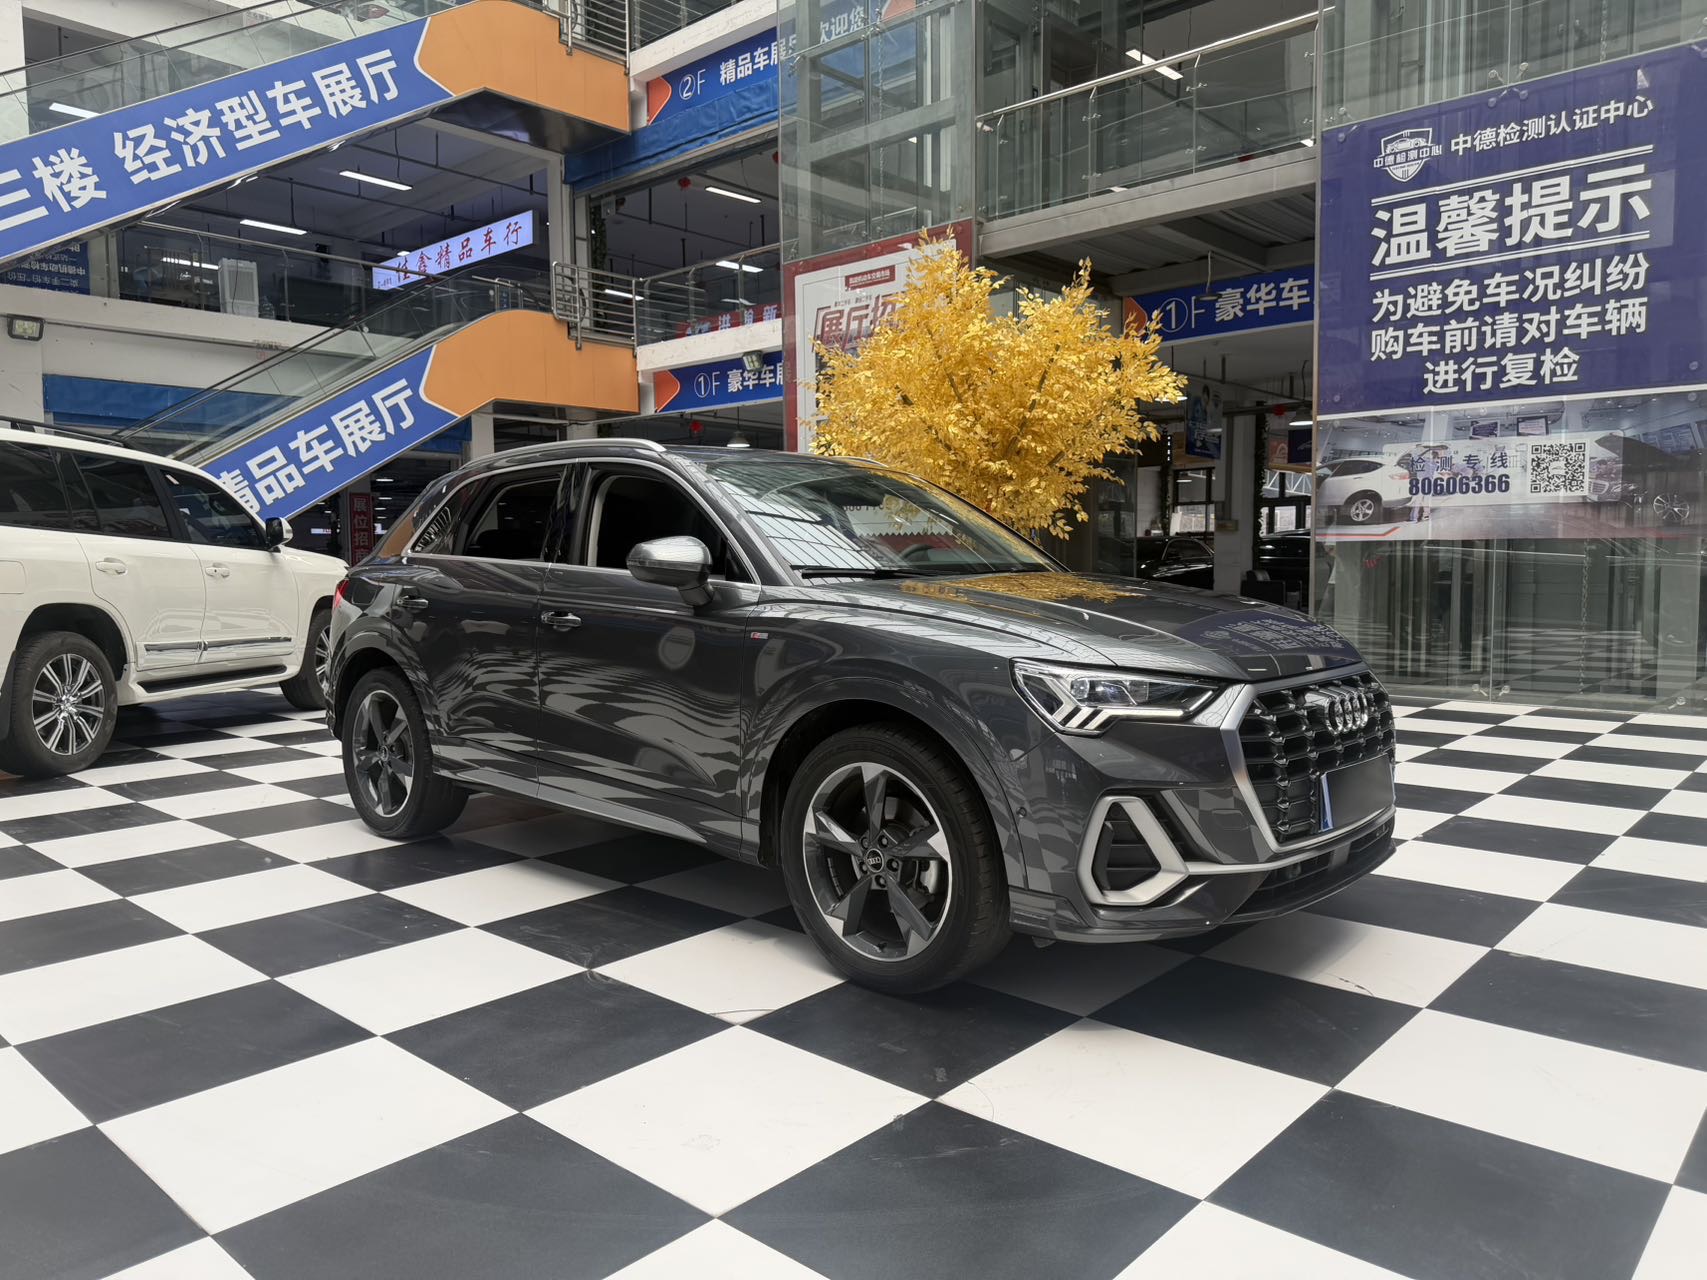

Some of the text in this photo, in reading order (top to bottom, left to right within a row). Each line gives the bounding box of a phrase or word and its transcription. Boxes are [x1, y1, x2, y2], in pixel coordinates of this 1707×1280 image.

[113, 49, 400, 185] 经济型车展厅
[1450, 95, 1653, 156] 中德检测认证中心
[1371, 164, 1652, 266] 温馨提示
[1215, 277, 1310, 322] 豪华车
[1372, 252, 1649, 322] 为避免车况纠纷
[1370, 297, 1648, 361] 购车前请对车辆
[1423, 347, 1580, 395] 进行复检
[1409, 474, 1510, 495] 80606366
[1411, 453, 1508, 472] 检测专线
